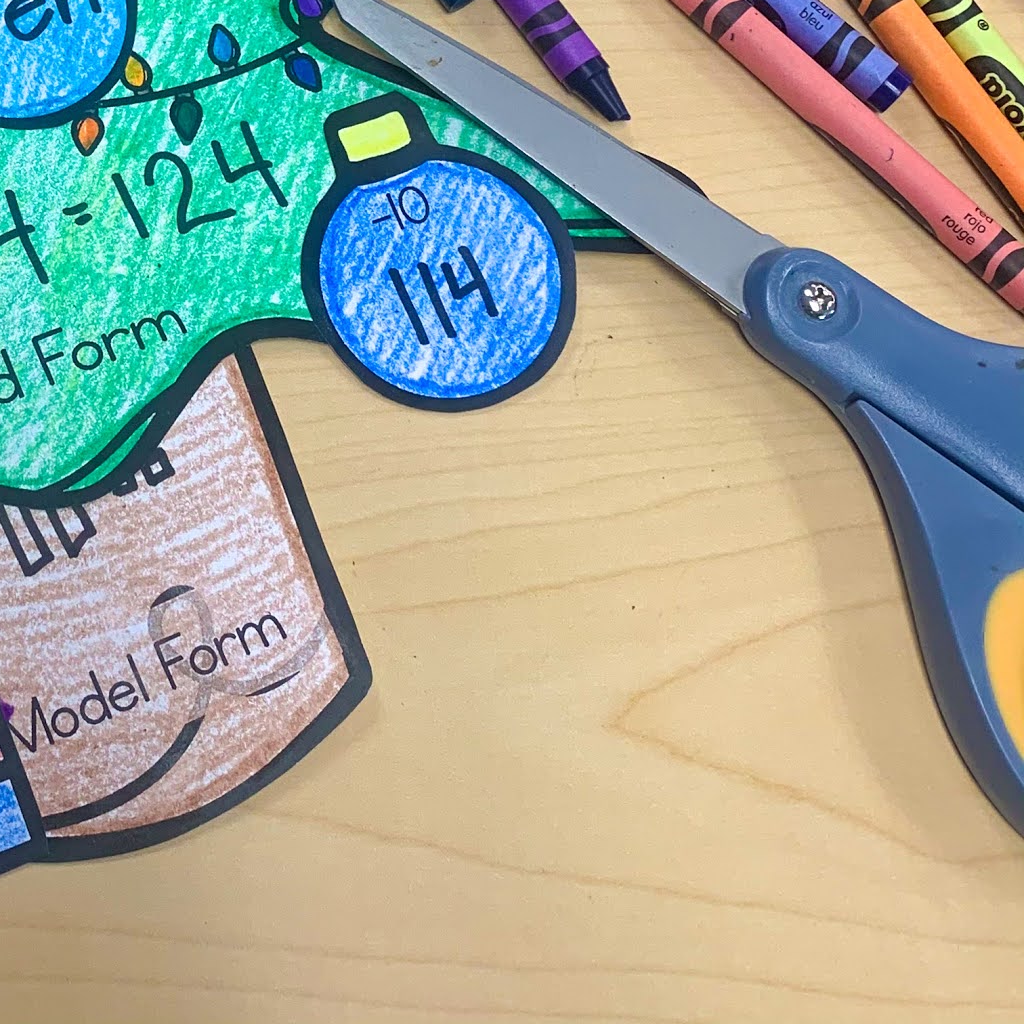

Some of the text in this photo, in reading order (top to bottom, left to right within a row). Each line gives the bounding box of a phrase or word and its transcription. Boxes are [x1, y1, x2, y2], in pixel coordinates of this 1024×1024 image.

[798, 7, 824, 31] bleu
[809, 1, 834, 21] azul
[110, 120, 288, 239] 124
[372, 185, 431, 232] -10
[941, 215, 975, 245] rouge
[963, 212, 986, 234] rojo
[388, 245, 499, 345] 114
[31, 310, 189, 386] Form
[154, 611, 288, 690] Form
